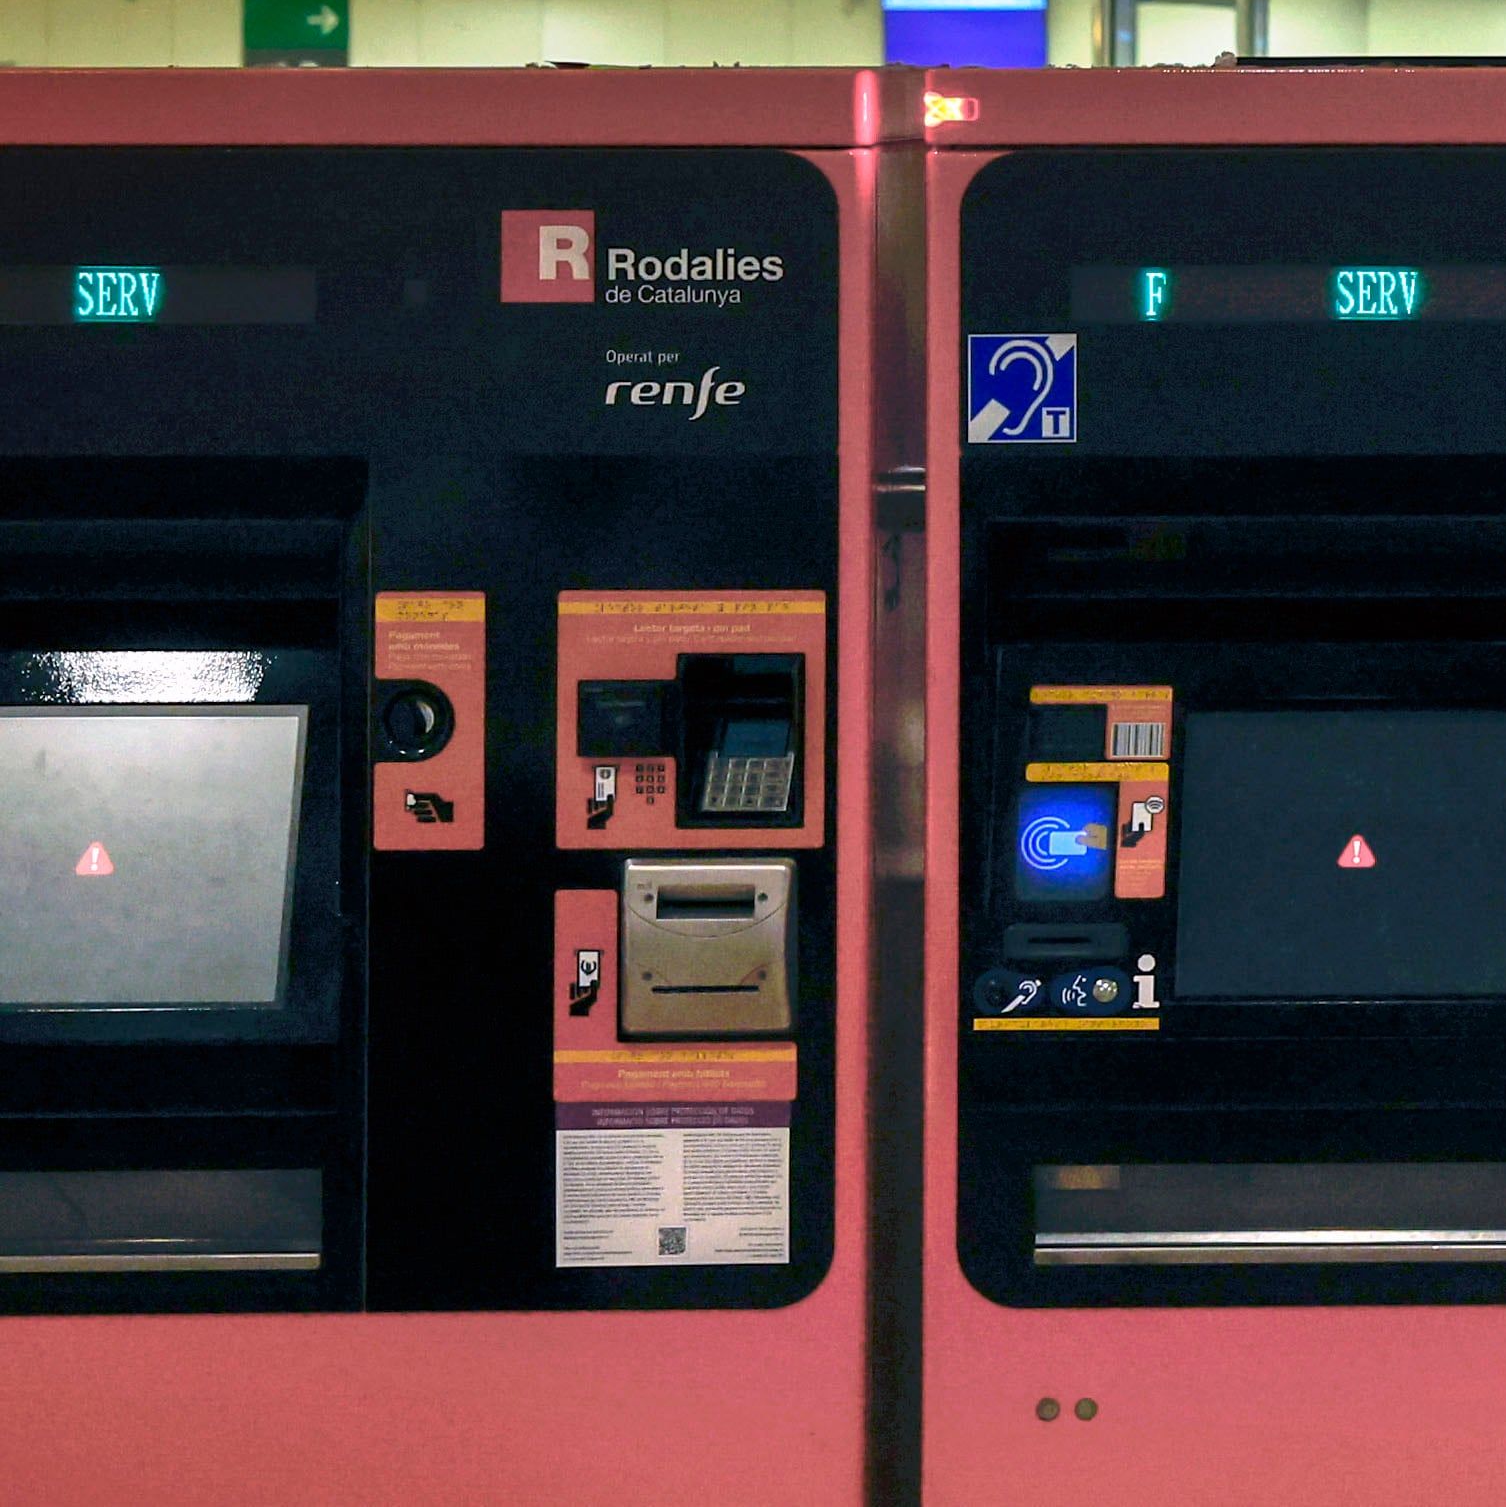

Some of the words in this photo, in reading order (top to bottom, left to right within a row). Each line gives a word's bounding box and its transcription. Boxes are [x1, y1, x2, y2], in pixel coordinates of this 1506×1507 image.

[538, 225, 590, 281] R
[608, 248, 784, 281] Rodalies
[77, 272, 160, 317] SERV
[605, 285, 632, 304] de
[637, 284, 741, 309] Catalunya
[1145, 272, 1167, 317] F
[1336, 270, 1417, 315] SERV
[605, 349, 653, 366] Operat
[657, 352, 679, 366] per
[605, 366, 746, 421] renfe
